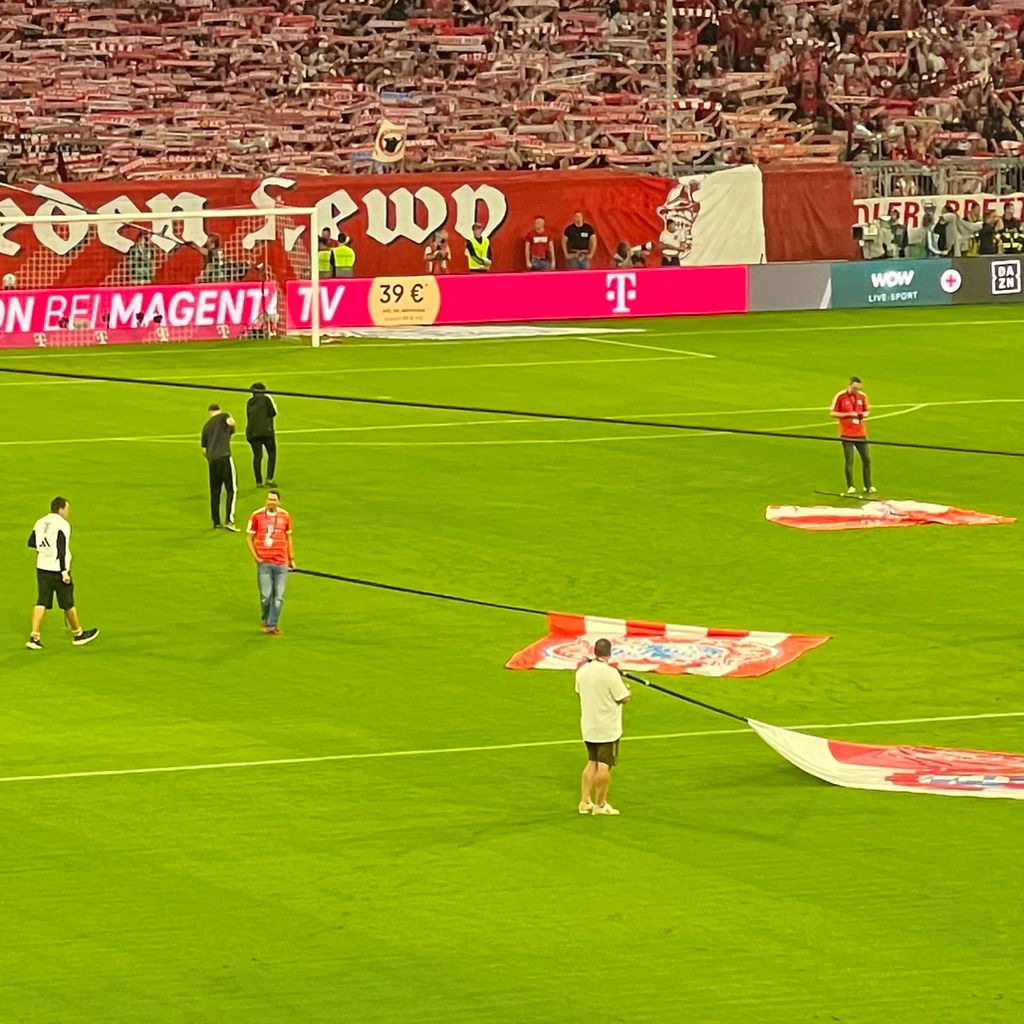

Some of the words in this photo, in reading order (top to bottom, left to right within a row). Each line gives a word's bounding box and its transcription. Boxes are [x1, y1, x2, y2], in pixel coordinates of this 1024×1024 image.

[871, 270, 914, 288] WOW
[380, 284, 404, 304] 39
[44, 293, 101, 331] BEI
[298, 285, 345, 322] TV
